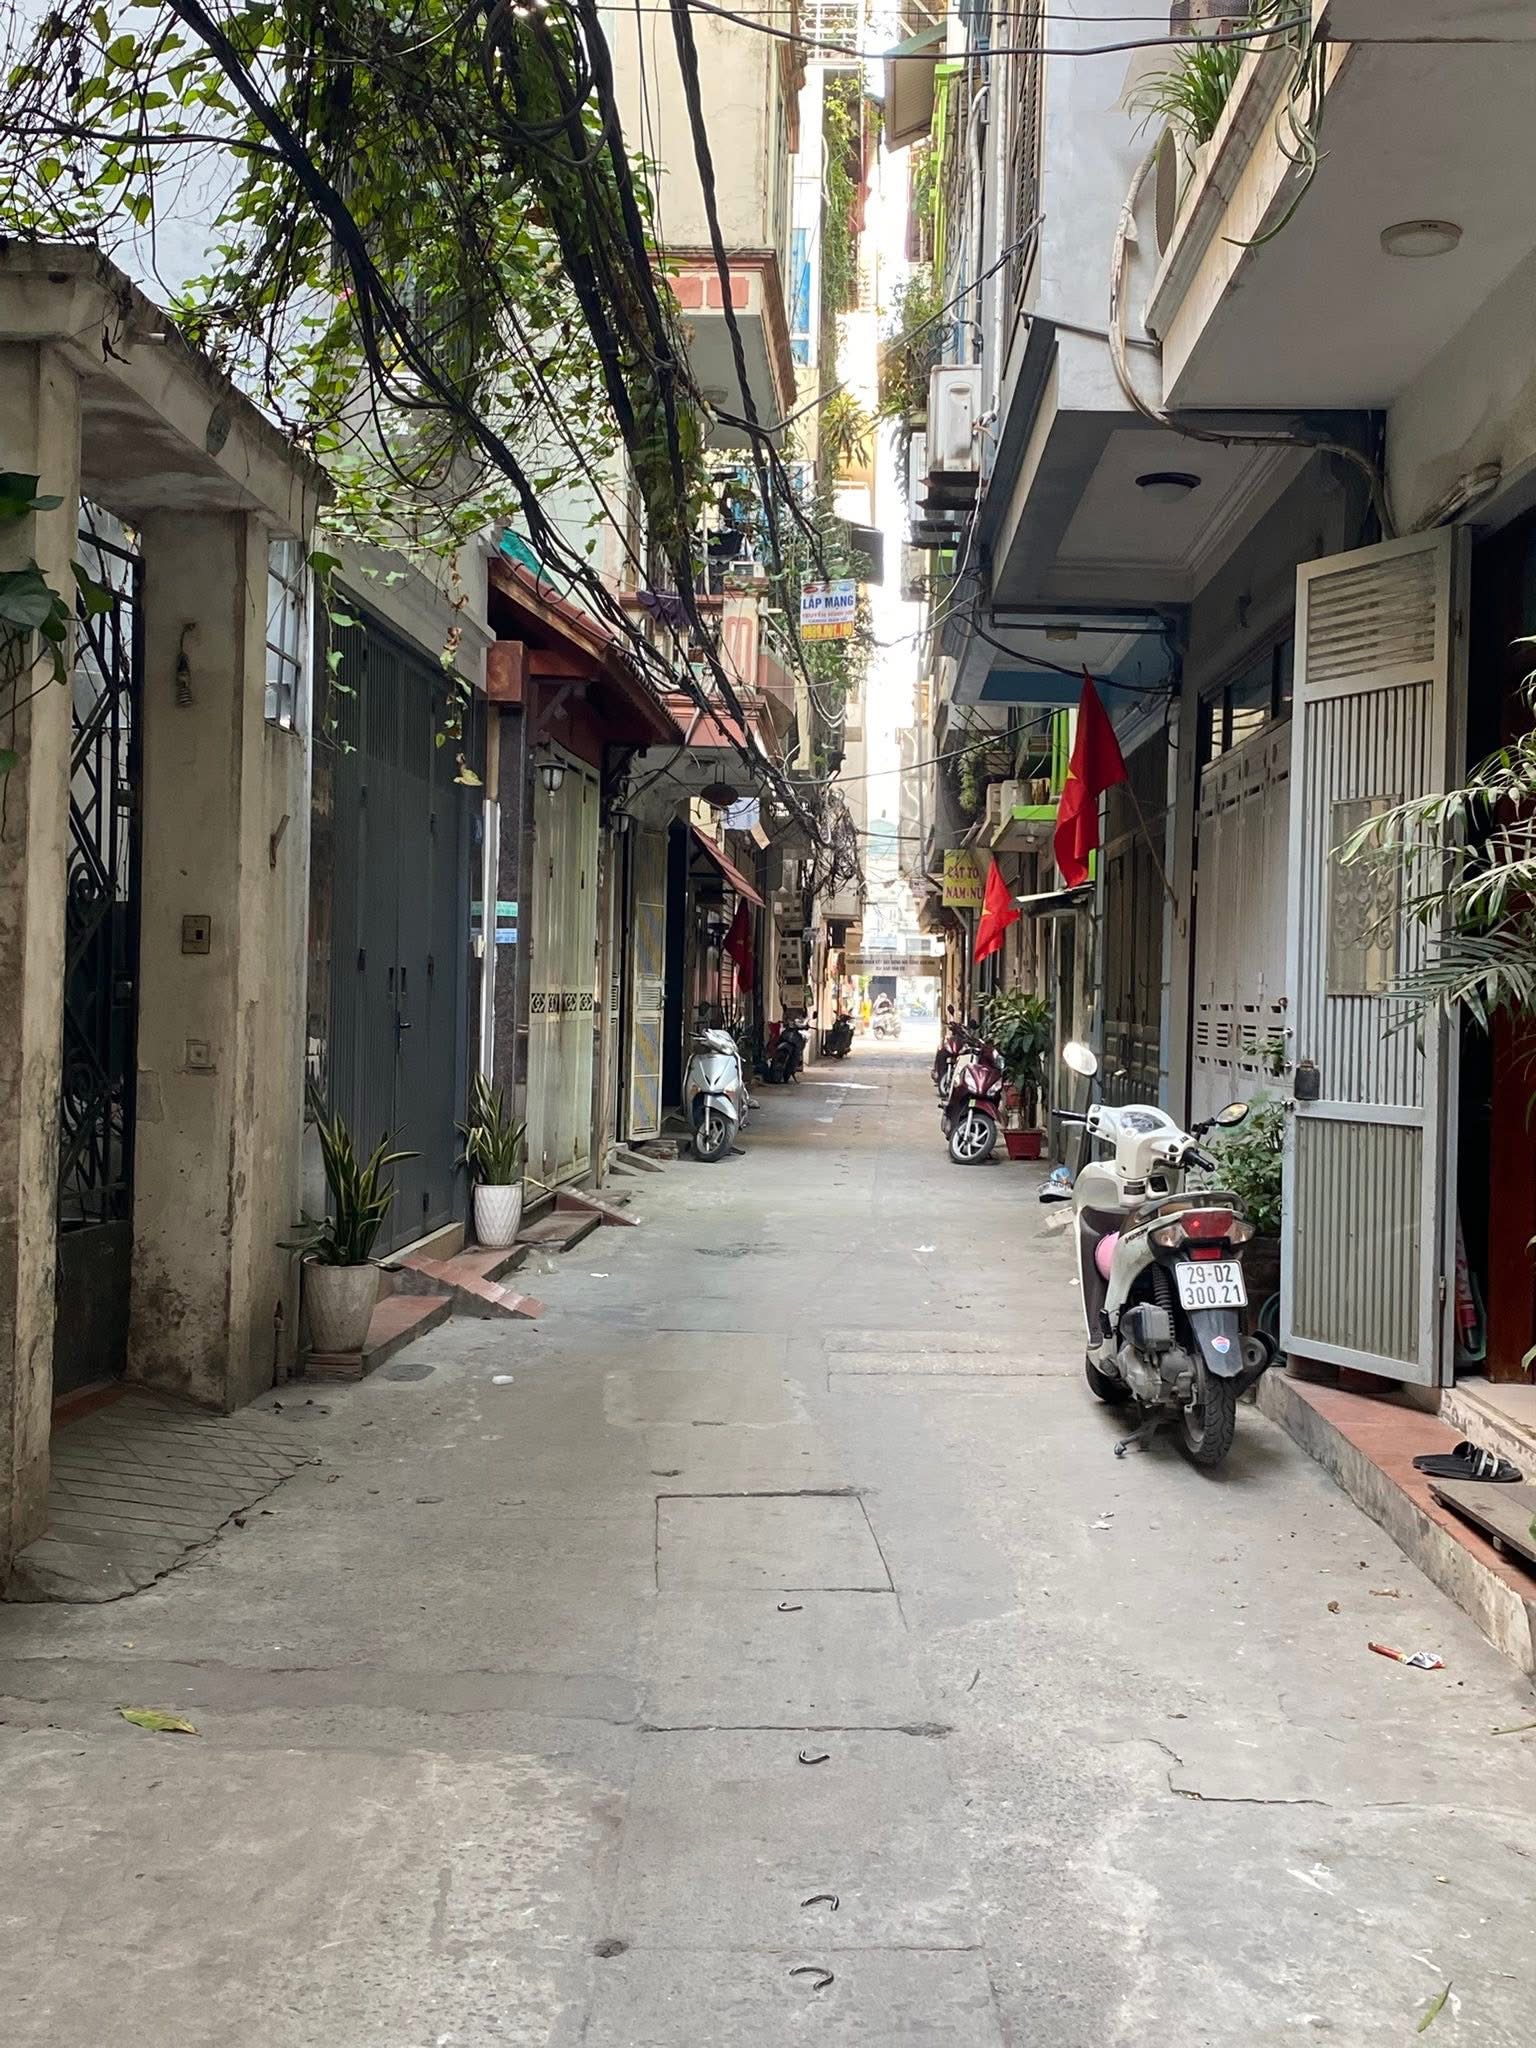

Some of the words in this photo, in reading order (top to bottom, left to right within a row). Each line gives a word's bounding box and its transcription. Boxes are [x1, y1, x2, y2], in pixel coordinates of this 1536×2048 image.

[825, 595, 853, 610] MẠNG
[1187, 1264, 1233, 1284] 29-D2
[1185, 1284, 1241, 1305] 300.21
